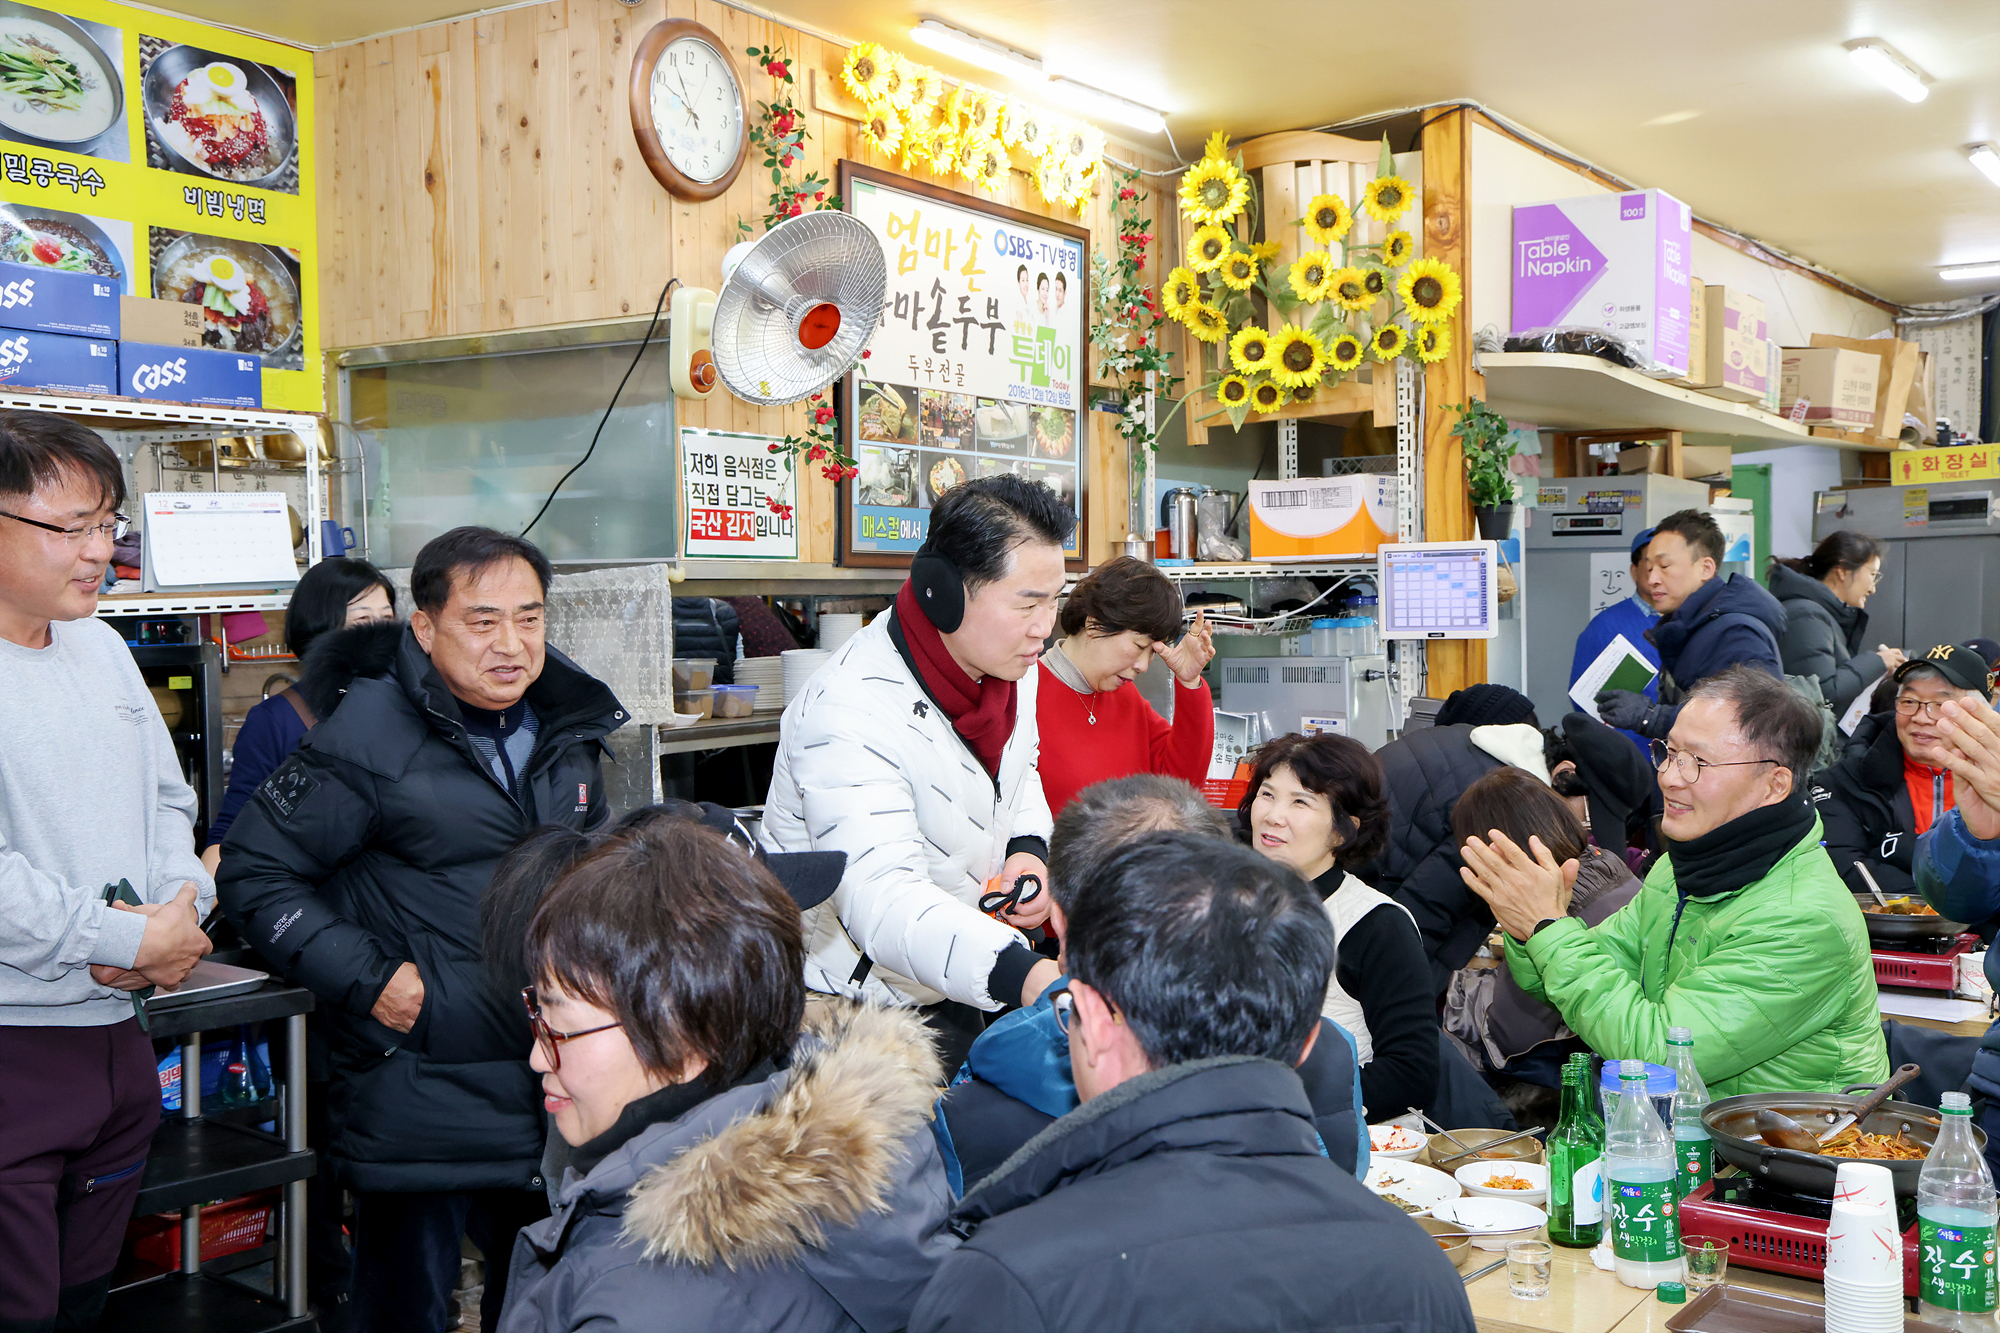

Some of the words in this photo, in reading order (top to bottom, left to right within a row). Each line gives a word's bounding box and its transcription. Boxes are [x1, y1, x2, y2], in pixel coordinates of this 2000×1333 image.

[685, 51, 695, 66] 12
[716, 87, 723, 101] 2
[720, 115, 728, 129] 3
[714, 140, 721, 153] 4
[684, 157, 692, 172] 6
[702, 155, 710, 170] 5
[0, 153, 105, 197] 밀콩국수
[183, 186, 266, 224] 비빔냉면
[886, 209, 986, 292] 엄마손
[1527, 256, 1592, 278] Napkin
[1666, 262, 1688, 287] Napkin
[183, 310, 199, 320] 처음
[184, 319, 200, 328] 처럼
[881, 277, 1007, 356] 마솥두부
[1009, 335, 1071, 383] 투데이
[132, 357, 187, 394] Cass
[908, 355, 965, 387] 두부전골
[1008, 384, 1030, 399] 2016년
[1031, 387, 1044, 402] 12월
[1045, 390, 1057, 404] 12일
[1058, 391, 1071, 406] 방영
[1052, 379, 1070, 392] Today
[690, 452, 718, 476] 저희
[724, 455, 777, 480] 음식점은
[1922, 452, 1987, 472] 화장실
[1940, 470, 1970, 479] TOILET
[158, 500, 168, 508] 12
[691, 483, 719, 505] 직접
[726, 485, 766, 508] 담그는
[692, 511, 722, 536] 국산
[862, 515, 921, 541] 매스컴에서
[1612, 1202, 1658, 1232] 장수
[1923, 1244, 1979, 1280] 장수
